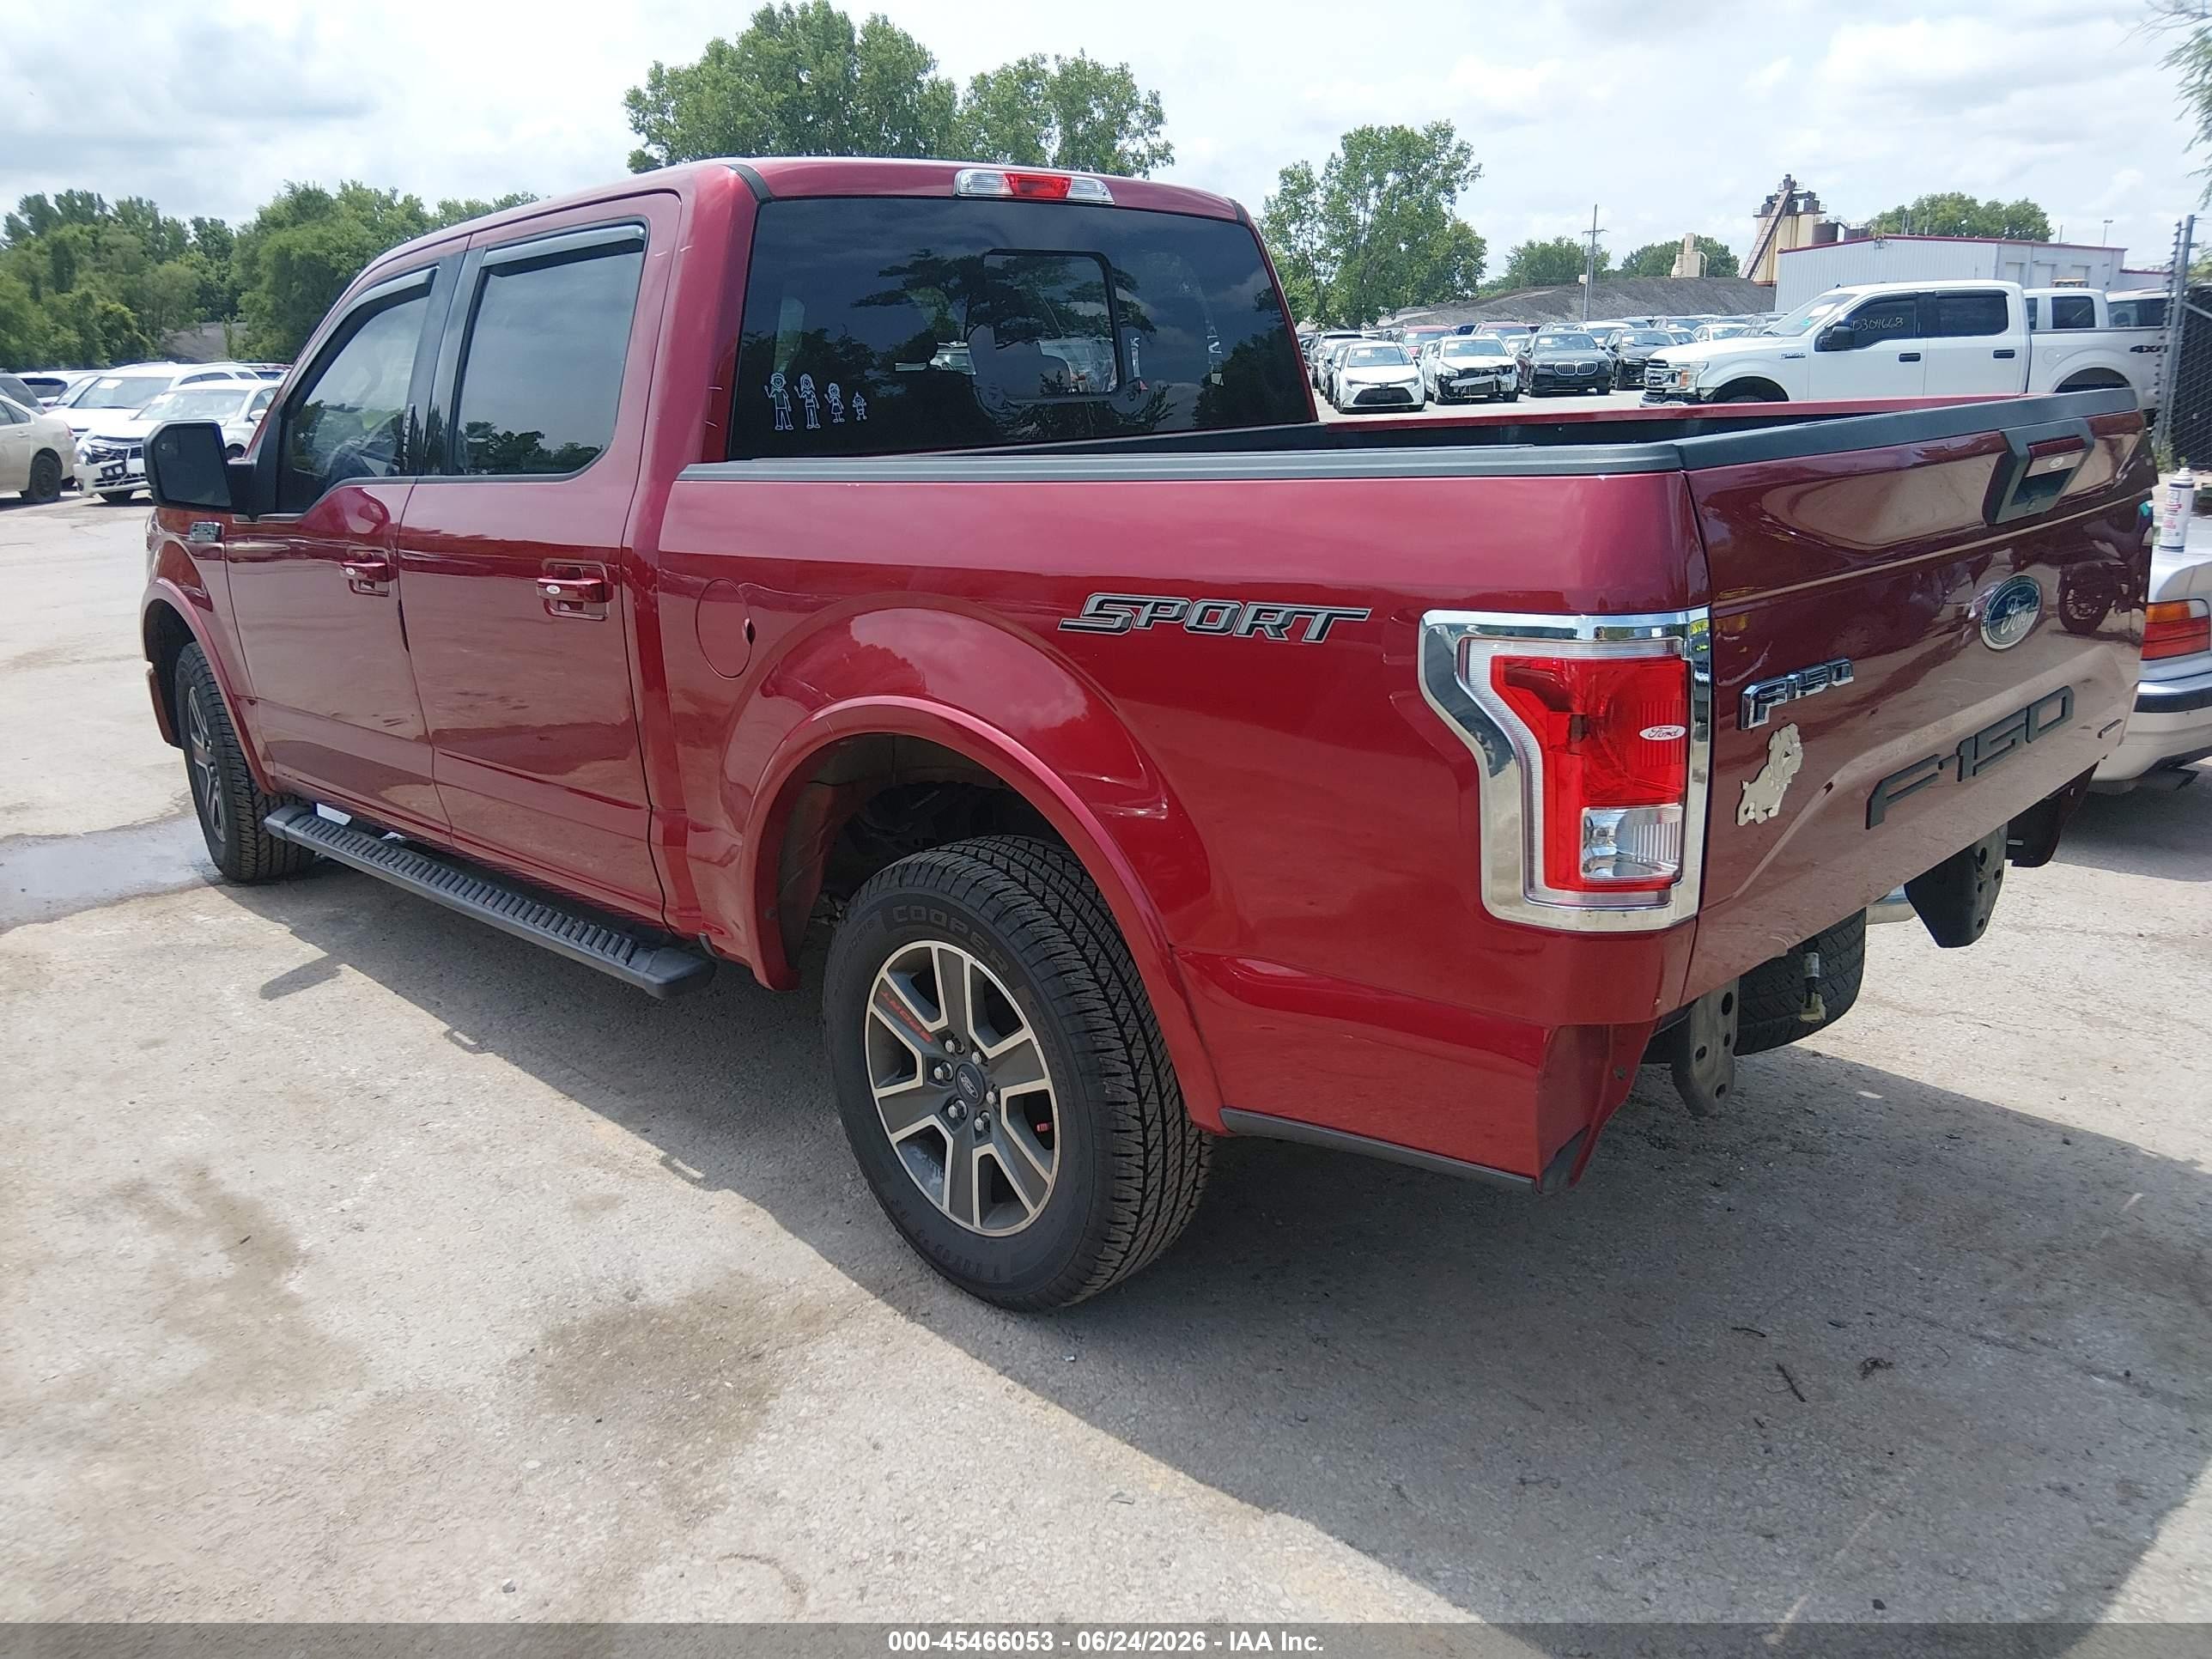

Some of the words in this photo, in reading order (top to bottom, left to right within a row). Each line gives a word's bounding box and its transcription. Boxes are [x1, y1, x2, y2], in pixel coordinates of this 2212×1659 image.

[1058, 592, 1374, 644] SPORT
[1865, 685, 2074, 830] F-150
[892, 905, 1010, 975] COOPER
